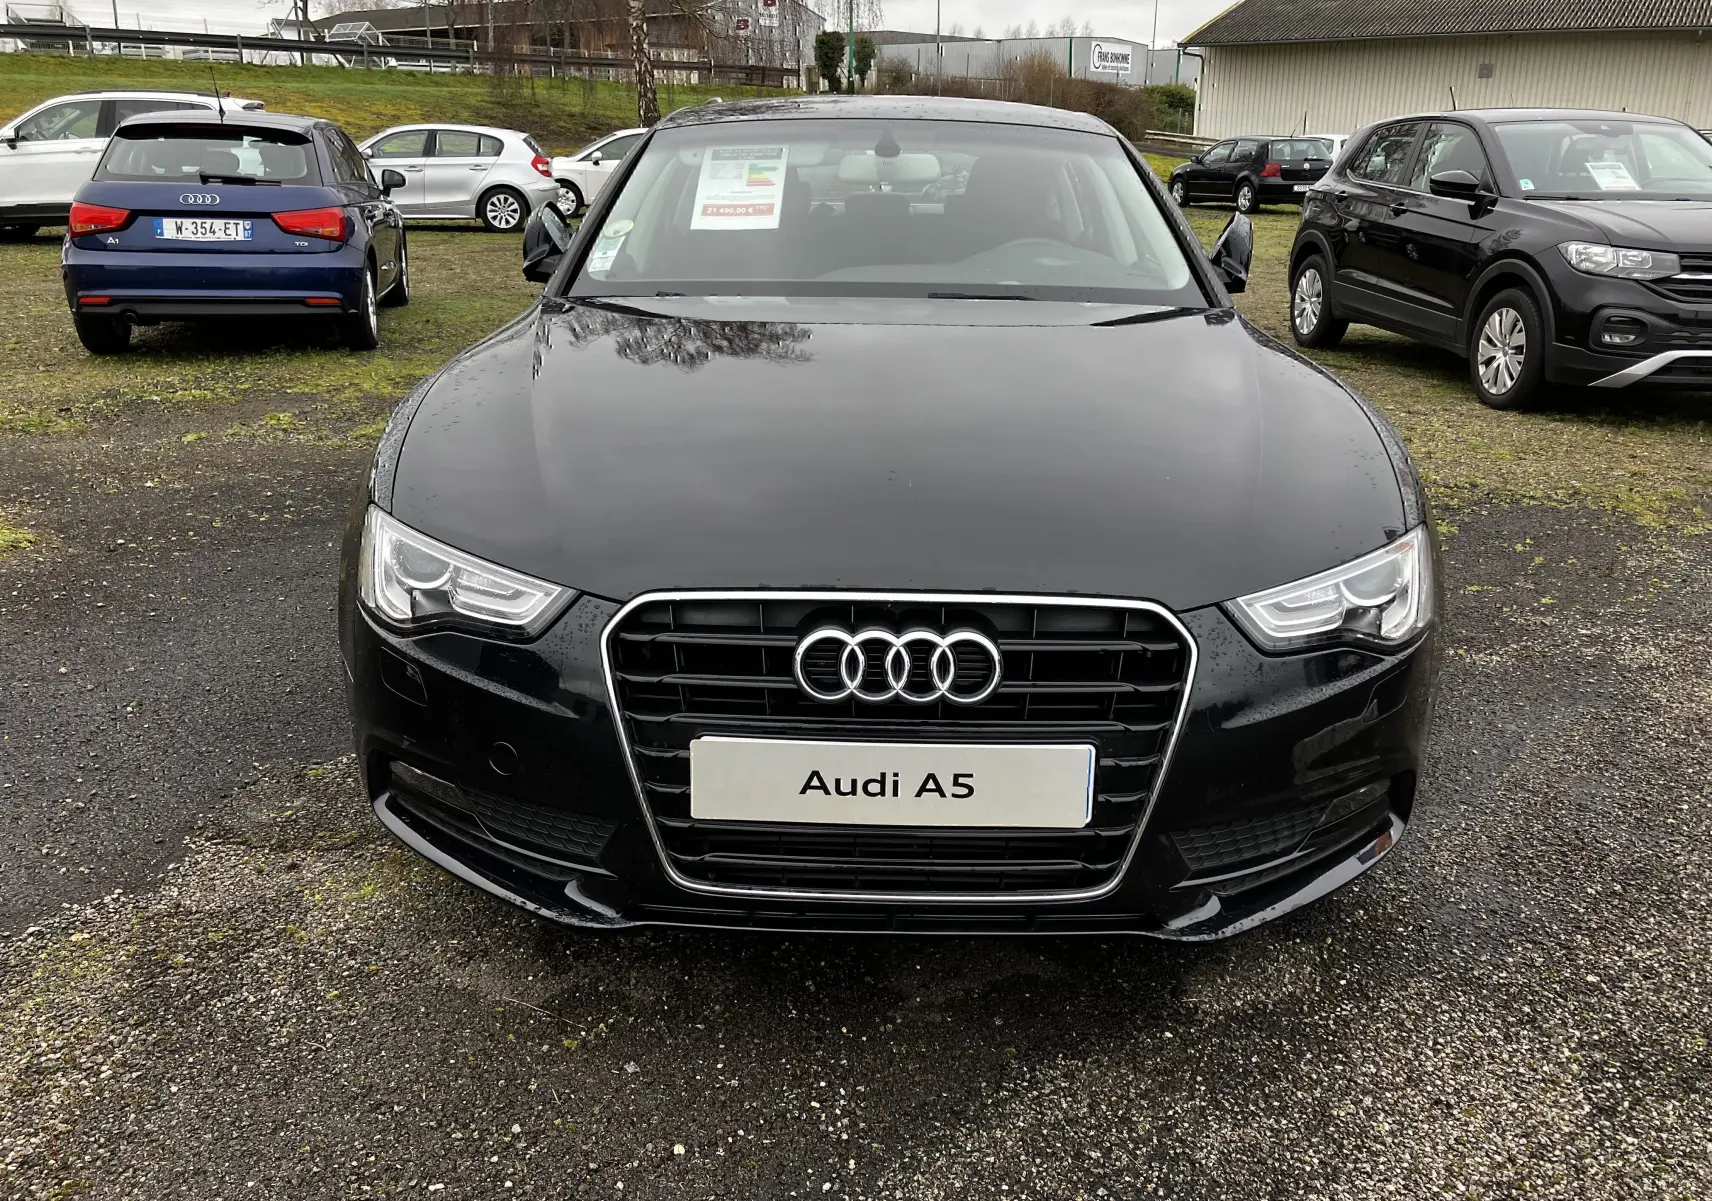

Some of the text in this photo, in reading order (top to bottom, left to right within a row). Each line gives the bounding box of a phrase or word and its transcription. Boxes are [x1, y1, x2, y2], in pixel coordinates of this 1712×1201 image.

[1098, 51, 1109, 63] FRANS
[175, 220, 240, 237] W-354-ET
[107, 236, 119, 244] A1
[799, 770, 976, 799] Audi A5
